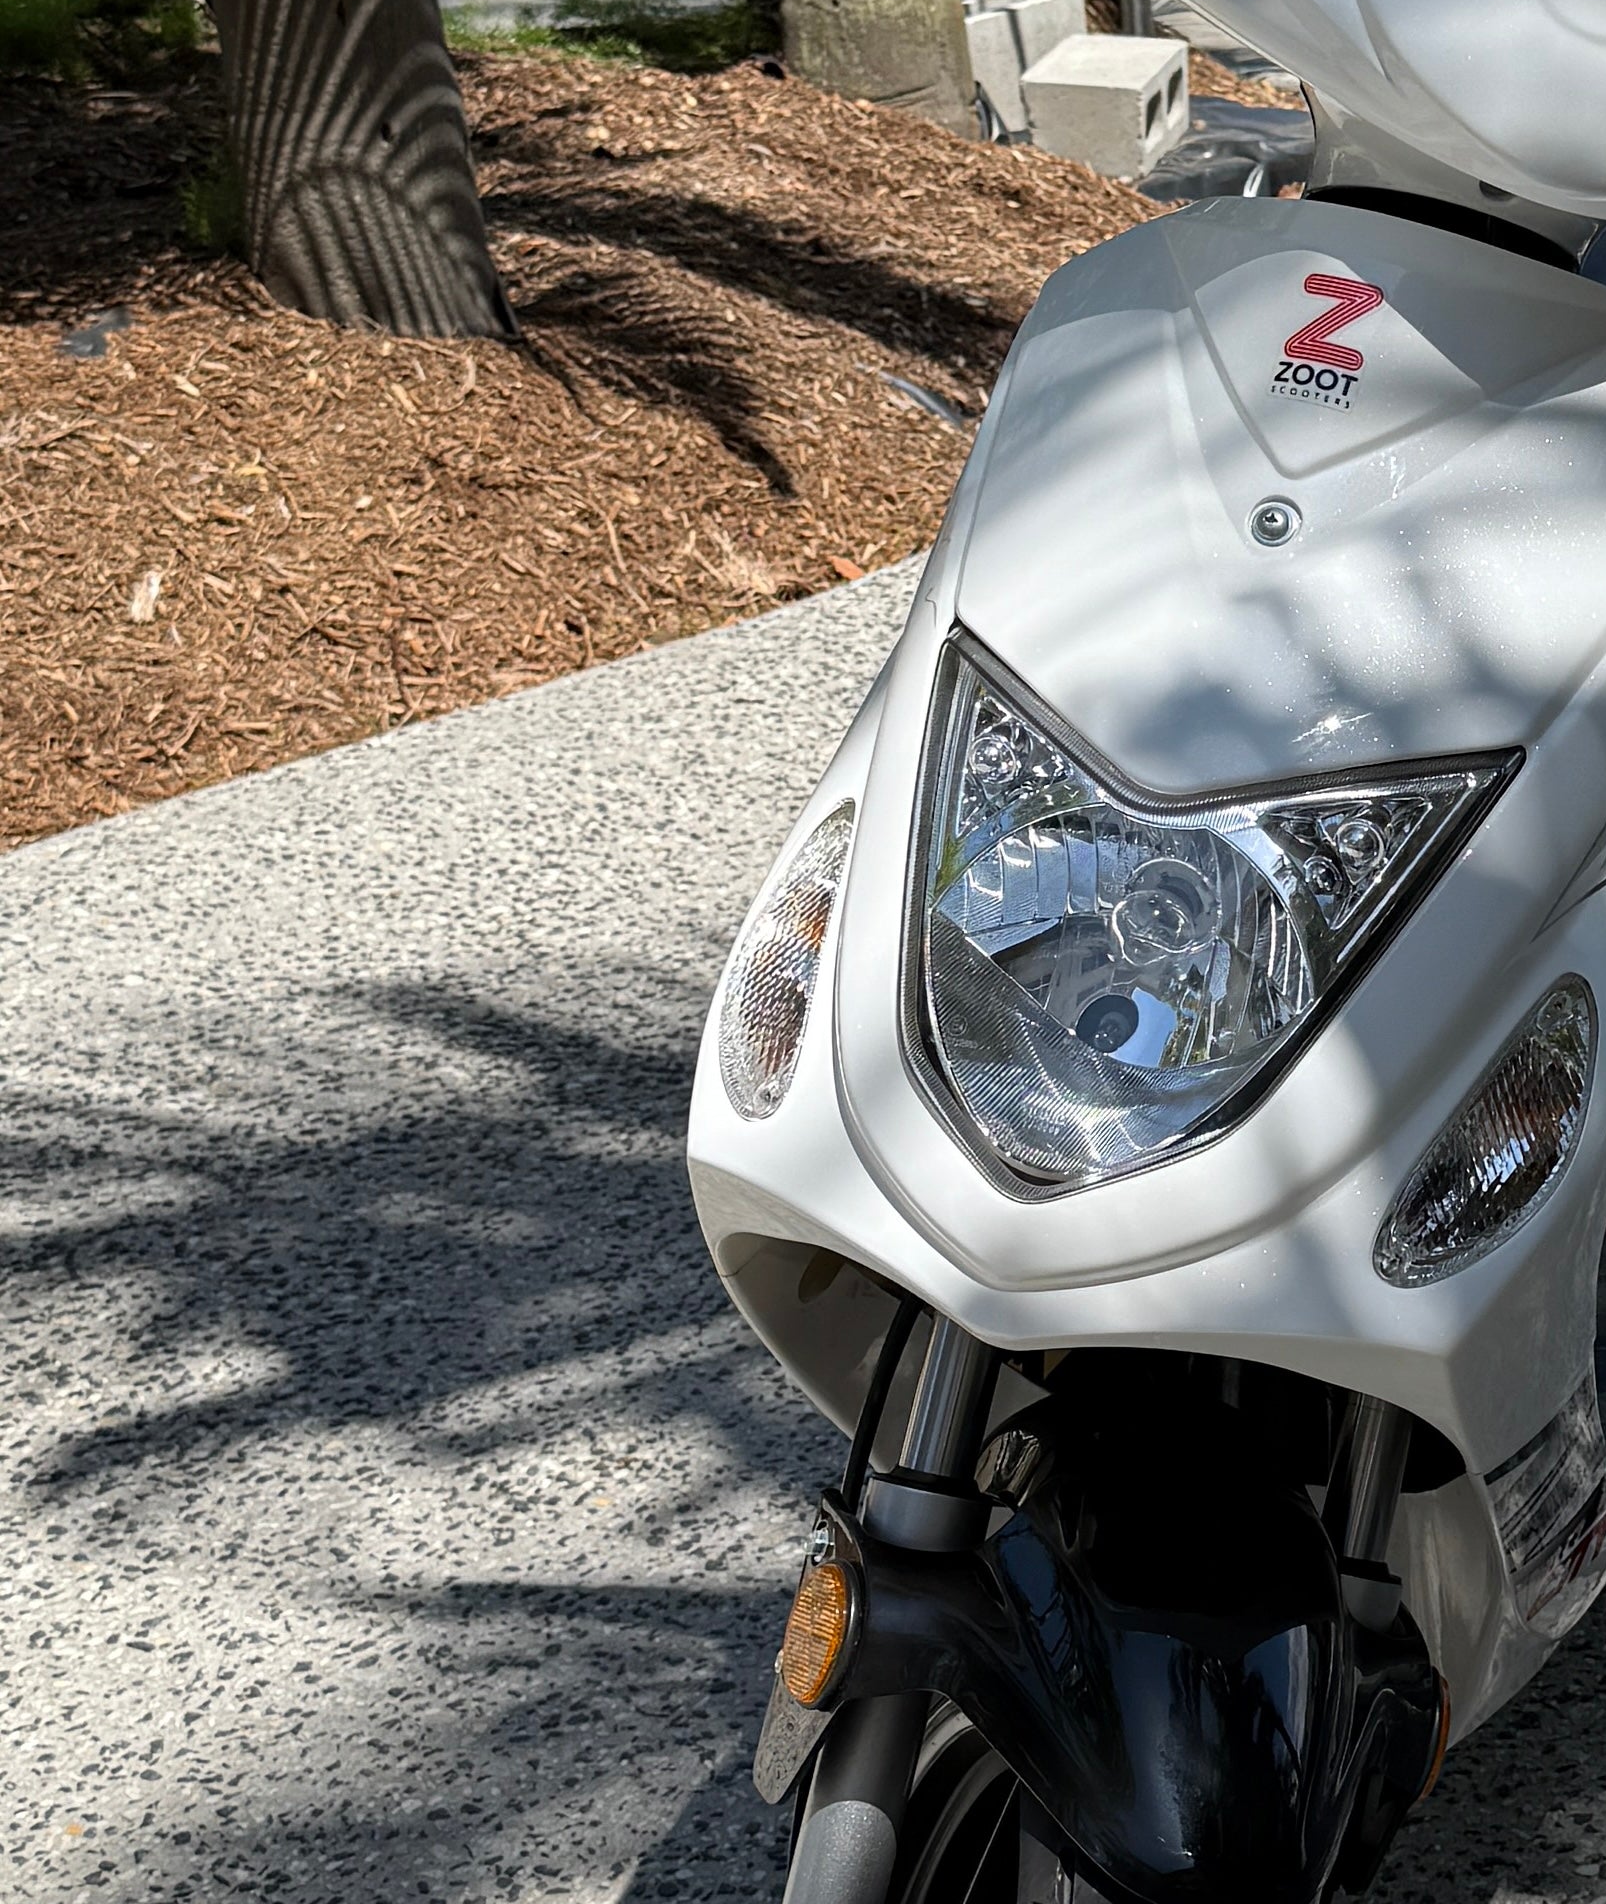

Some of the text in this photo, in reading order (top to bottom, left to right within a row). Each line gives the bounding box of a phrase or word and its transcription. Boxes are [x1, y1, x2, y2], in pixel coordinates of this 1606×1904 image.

[1284, 273, 1384, 371] Z
[1274, 361, 1358, 396] ZOOT
[1271, 385, 1351, 409] SCOOTERS
